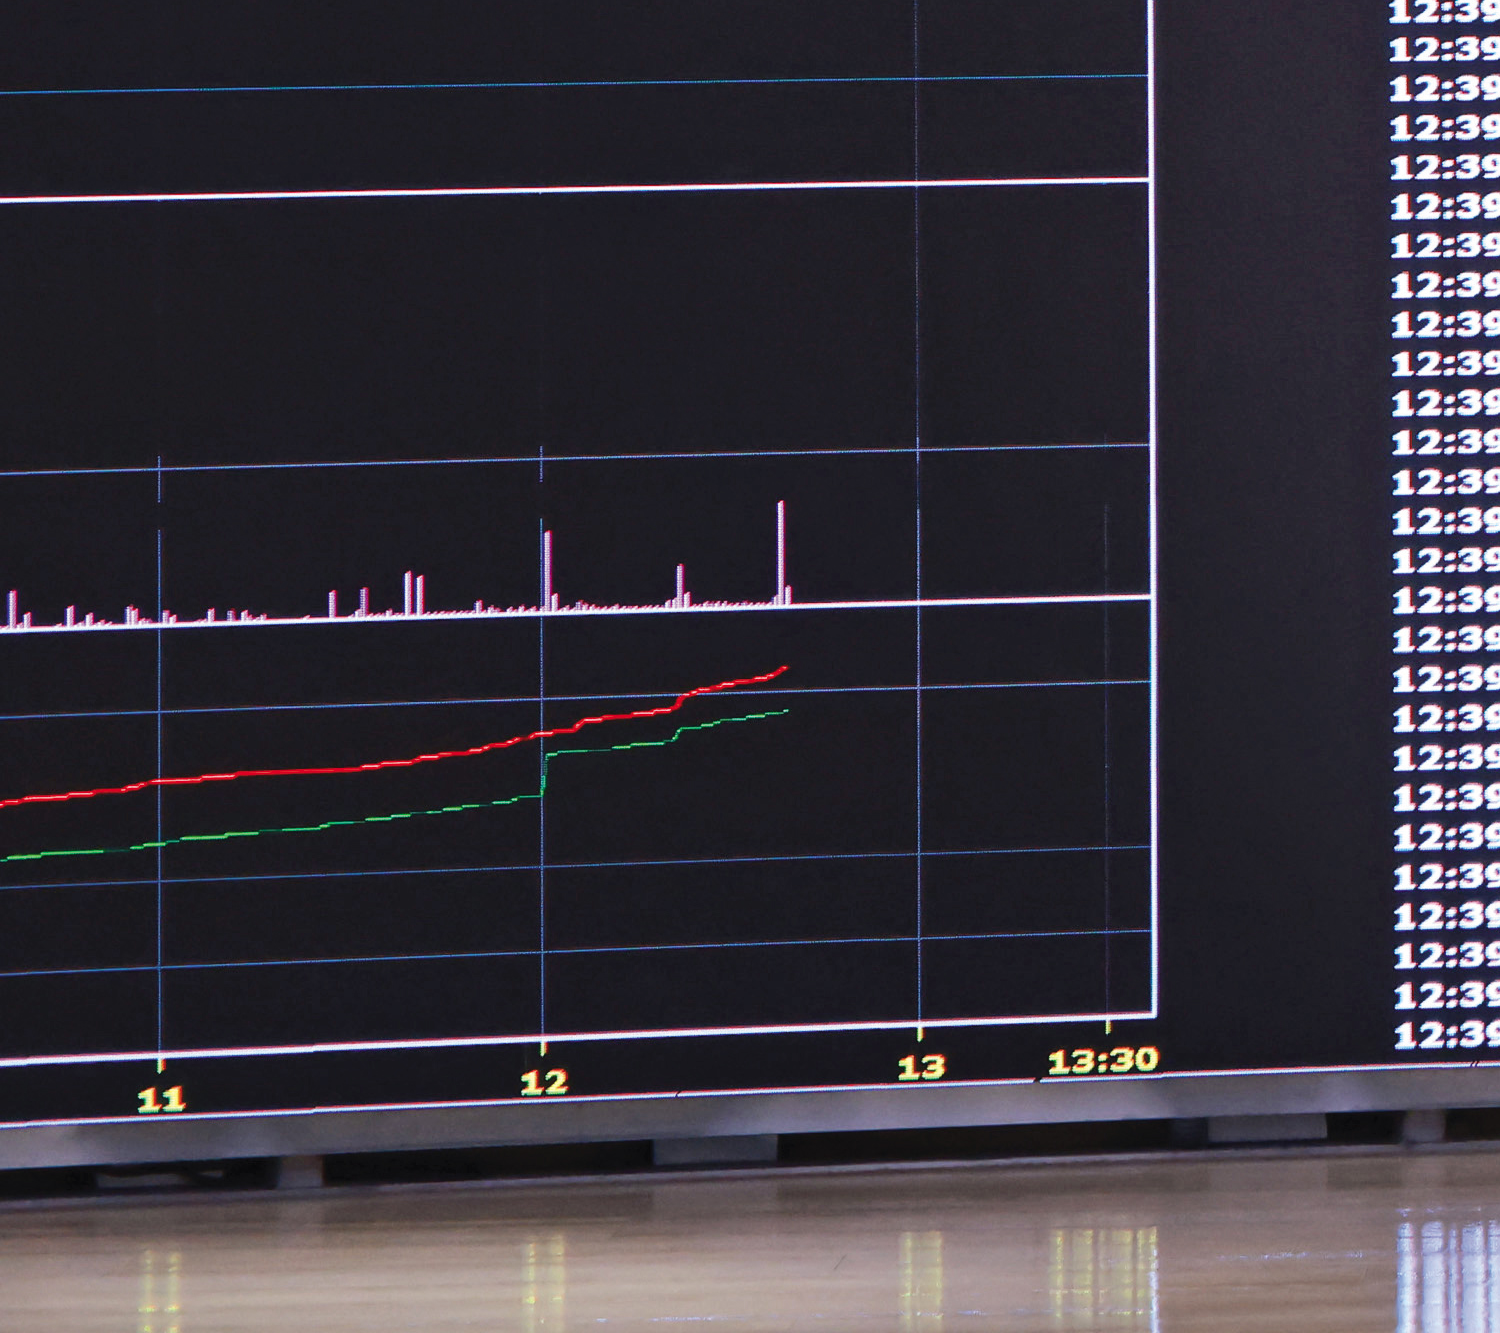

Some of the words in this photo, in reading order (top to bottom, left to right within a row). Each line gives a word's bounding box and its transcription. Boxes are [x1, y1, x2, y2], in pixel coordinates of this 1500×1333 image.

[140, 1087, 185, 1111] 11
[522, 1070, 567, 1094] 12
[899, 1055, 944, 1079] 13
[1049, 1047, 1158, 1073] 13:30
